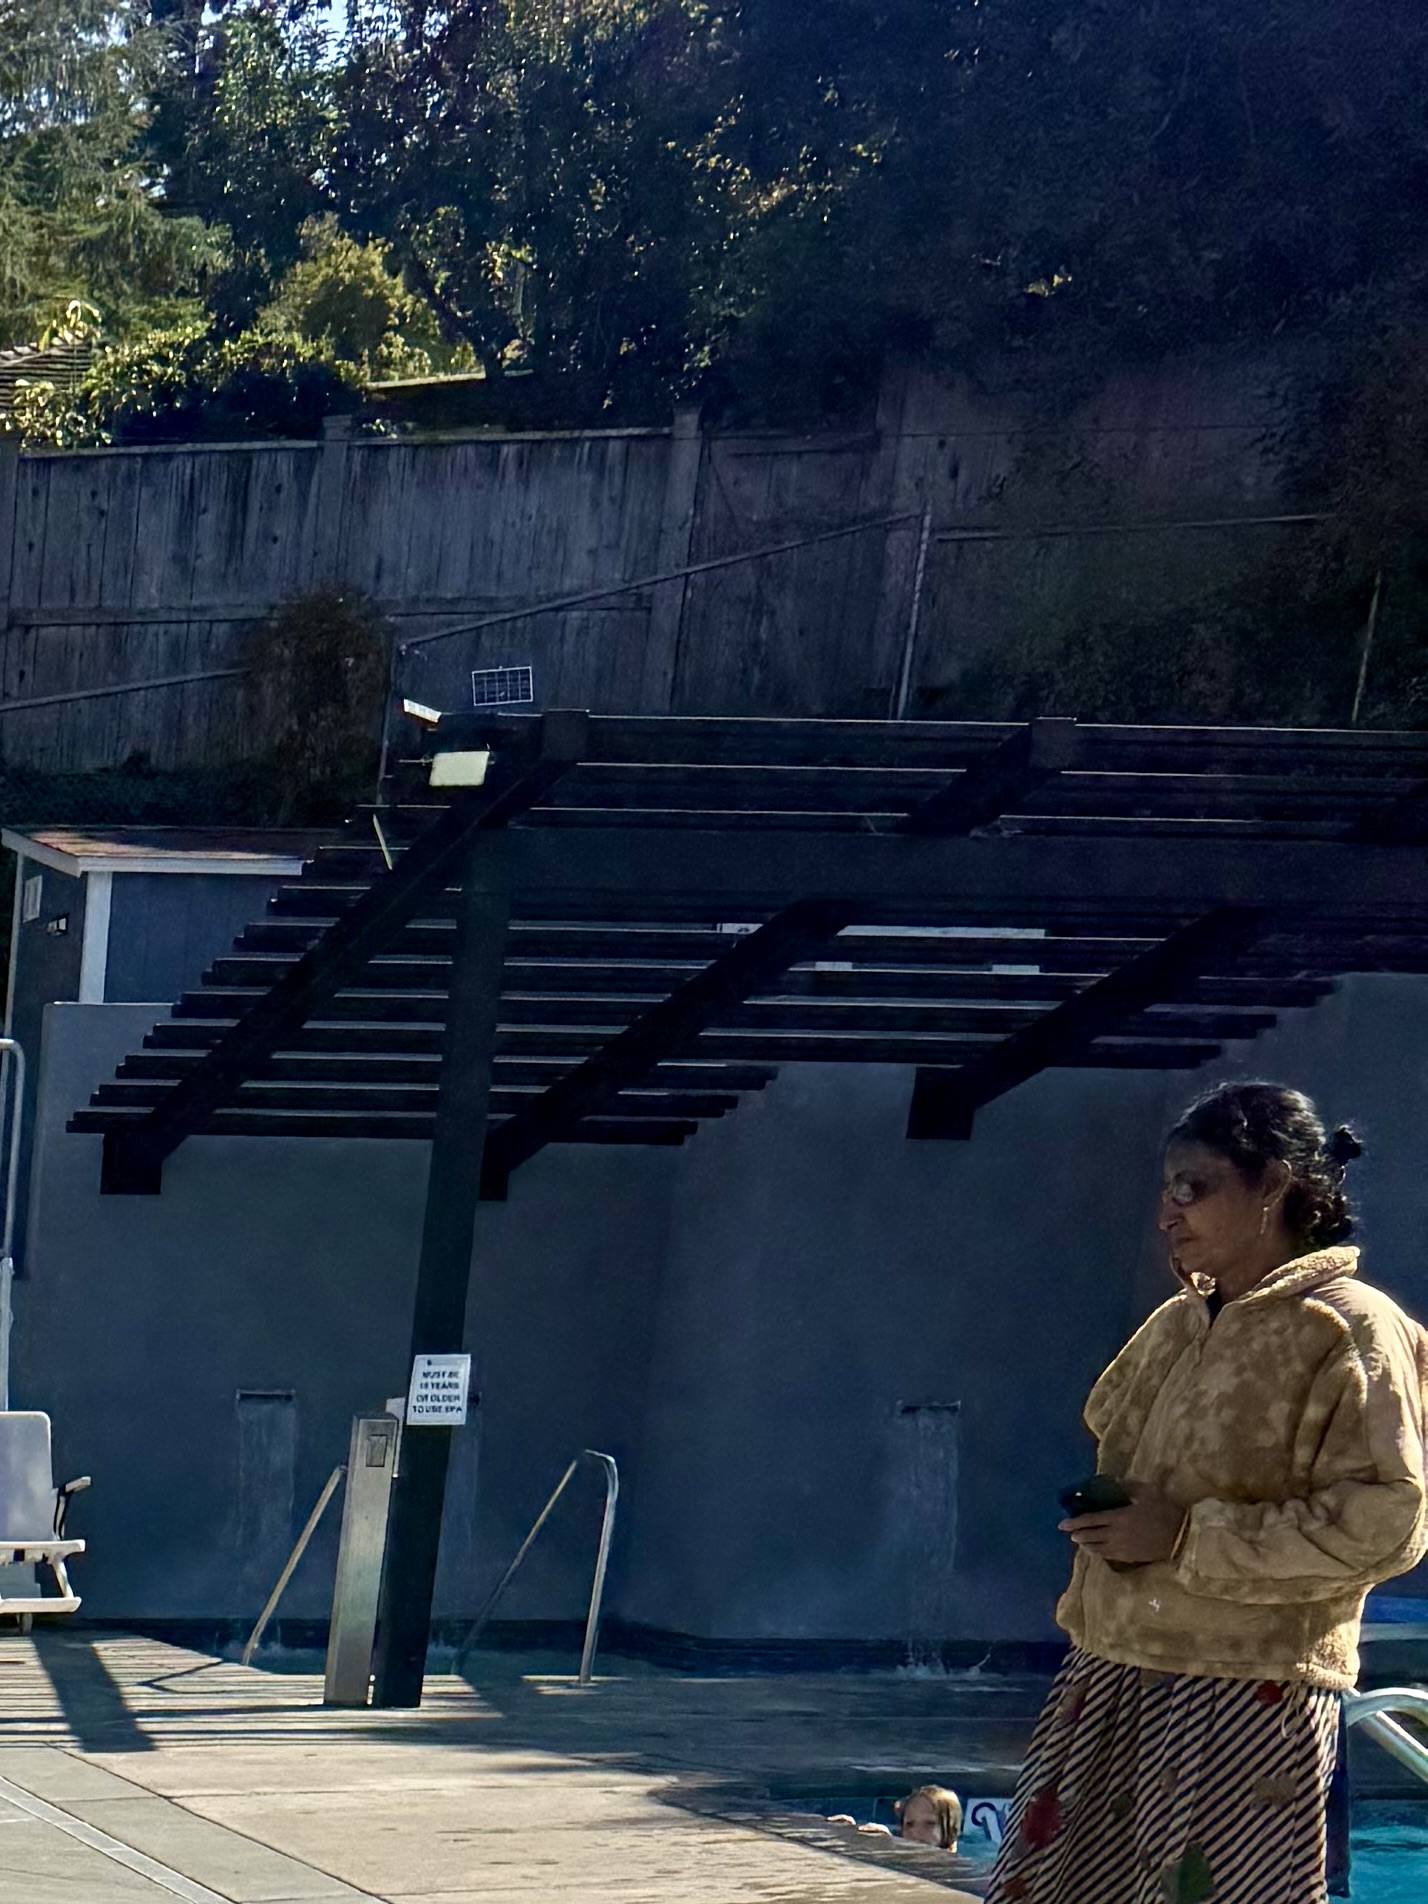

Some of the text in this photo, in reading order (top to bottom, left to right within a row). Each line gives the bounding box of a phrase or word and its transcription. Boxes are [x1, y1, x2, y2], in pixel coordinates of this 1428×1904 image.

[430, 1382, 460, 1390] YEARS
[416, 1394, 461, 1403] OR OLDER
[412, 1405, 463, 1414] TO USE SPA
